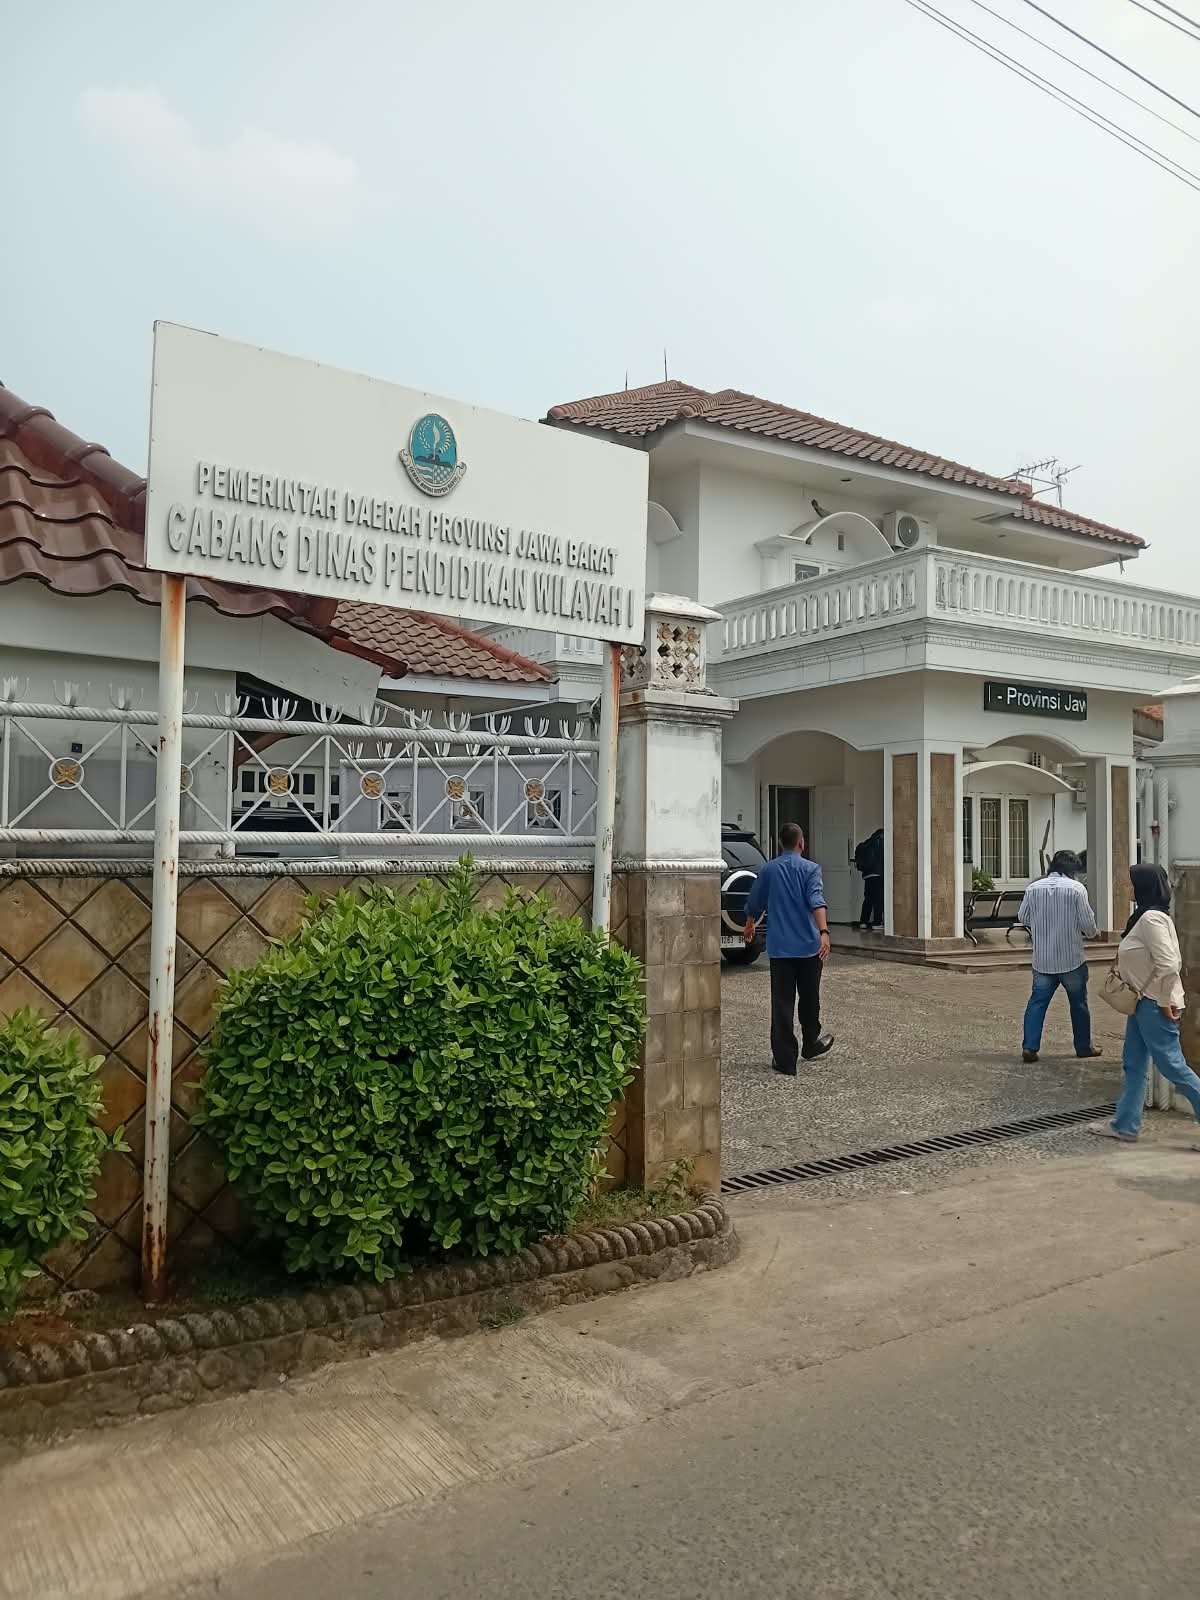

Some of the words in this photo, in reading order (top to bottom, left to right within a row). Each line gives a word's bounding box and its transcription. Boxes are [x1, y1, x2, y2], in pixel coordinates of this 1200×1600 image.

[167, 502, 289, 569] CABANG
[297, 526, 377, 584] DINAS
[385, 543, 528, 610] PENDIDIKAN
[533, 571, 623, 626] WILAYAH
[627, 588, 635, 628] I
[198, 461, 338, 521] PEMERINTAH
[345, 491, 422, 538] DAERAH
[428, 510, 511, 556] PROVINSI
[516, 529, 563, 565] JAWA
[567, 539, 618, 576] BARAT
[1006, 686, 1061, 711] Provinsi
